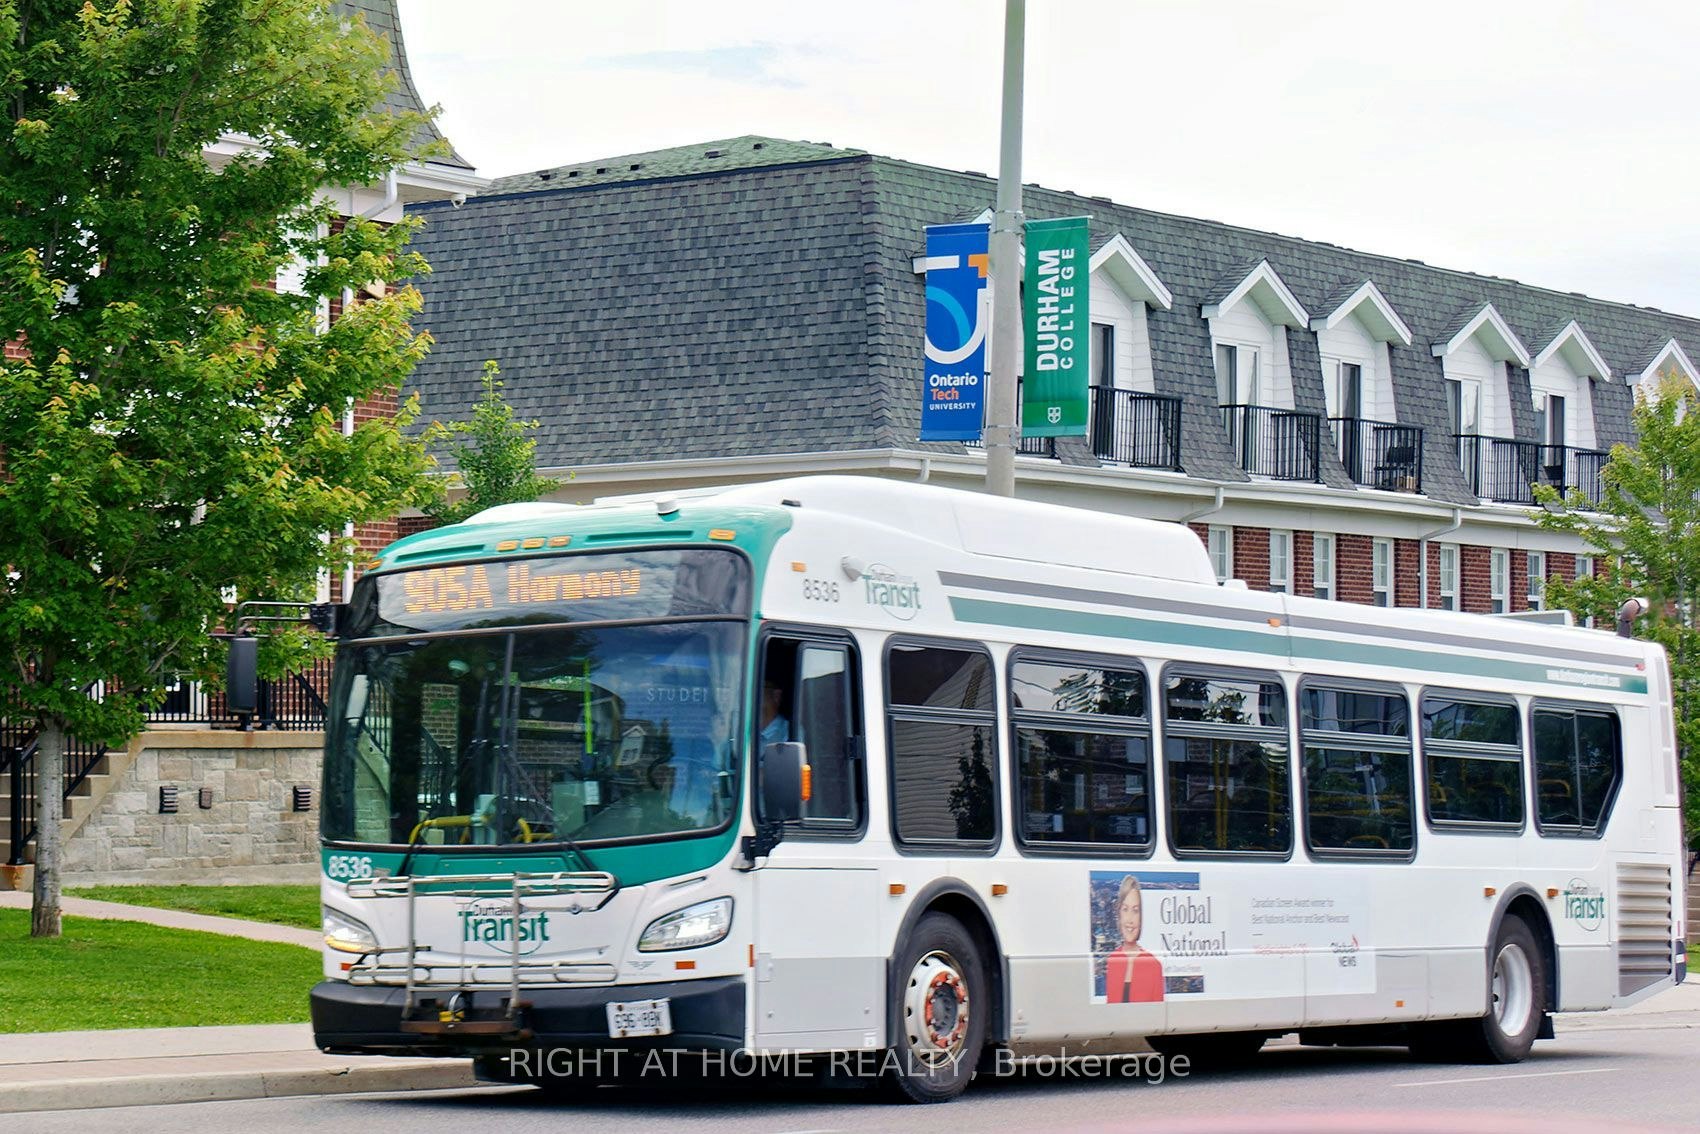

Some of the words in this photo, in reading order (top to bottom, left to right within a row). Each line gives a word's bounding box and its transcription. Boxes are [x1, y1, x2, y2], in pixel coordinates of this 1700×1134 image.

[1036, 249, 1060, 371] DURHAM
[1060, 248, 1075, 369] COLLEGE
[929, 372, 978, 387] Ontario
[929, 402, 976, 411] UNIVERSITY
[931, 387, 959, 401] Tech
[403, 565, 493, 614] 905A
[508, 564, 640, 603] Harmony
[803, 578, 840, 603] 8536
[862, 573, 922, 609] Transit
[328, 856, 372, 878] 8536
[1160, 896, 1212, 924] Global
[1563, 890, 1605, 919] Transit
[458, 910, 549, 942] Transit
[1160, 931, 1228, 957] National
